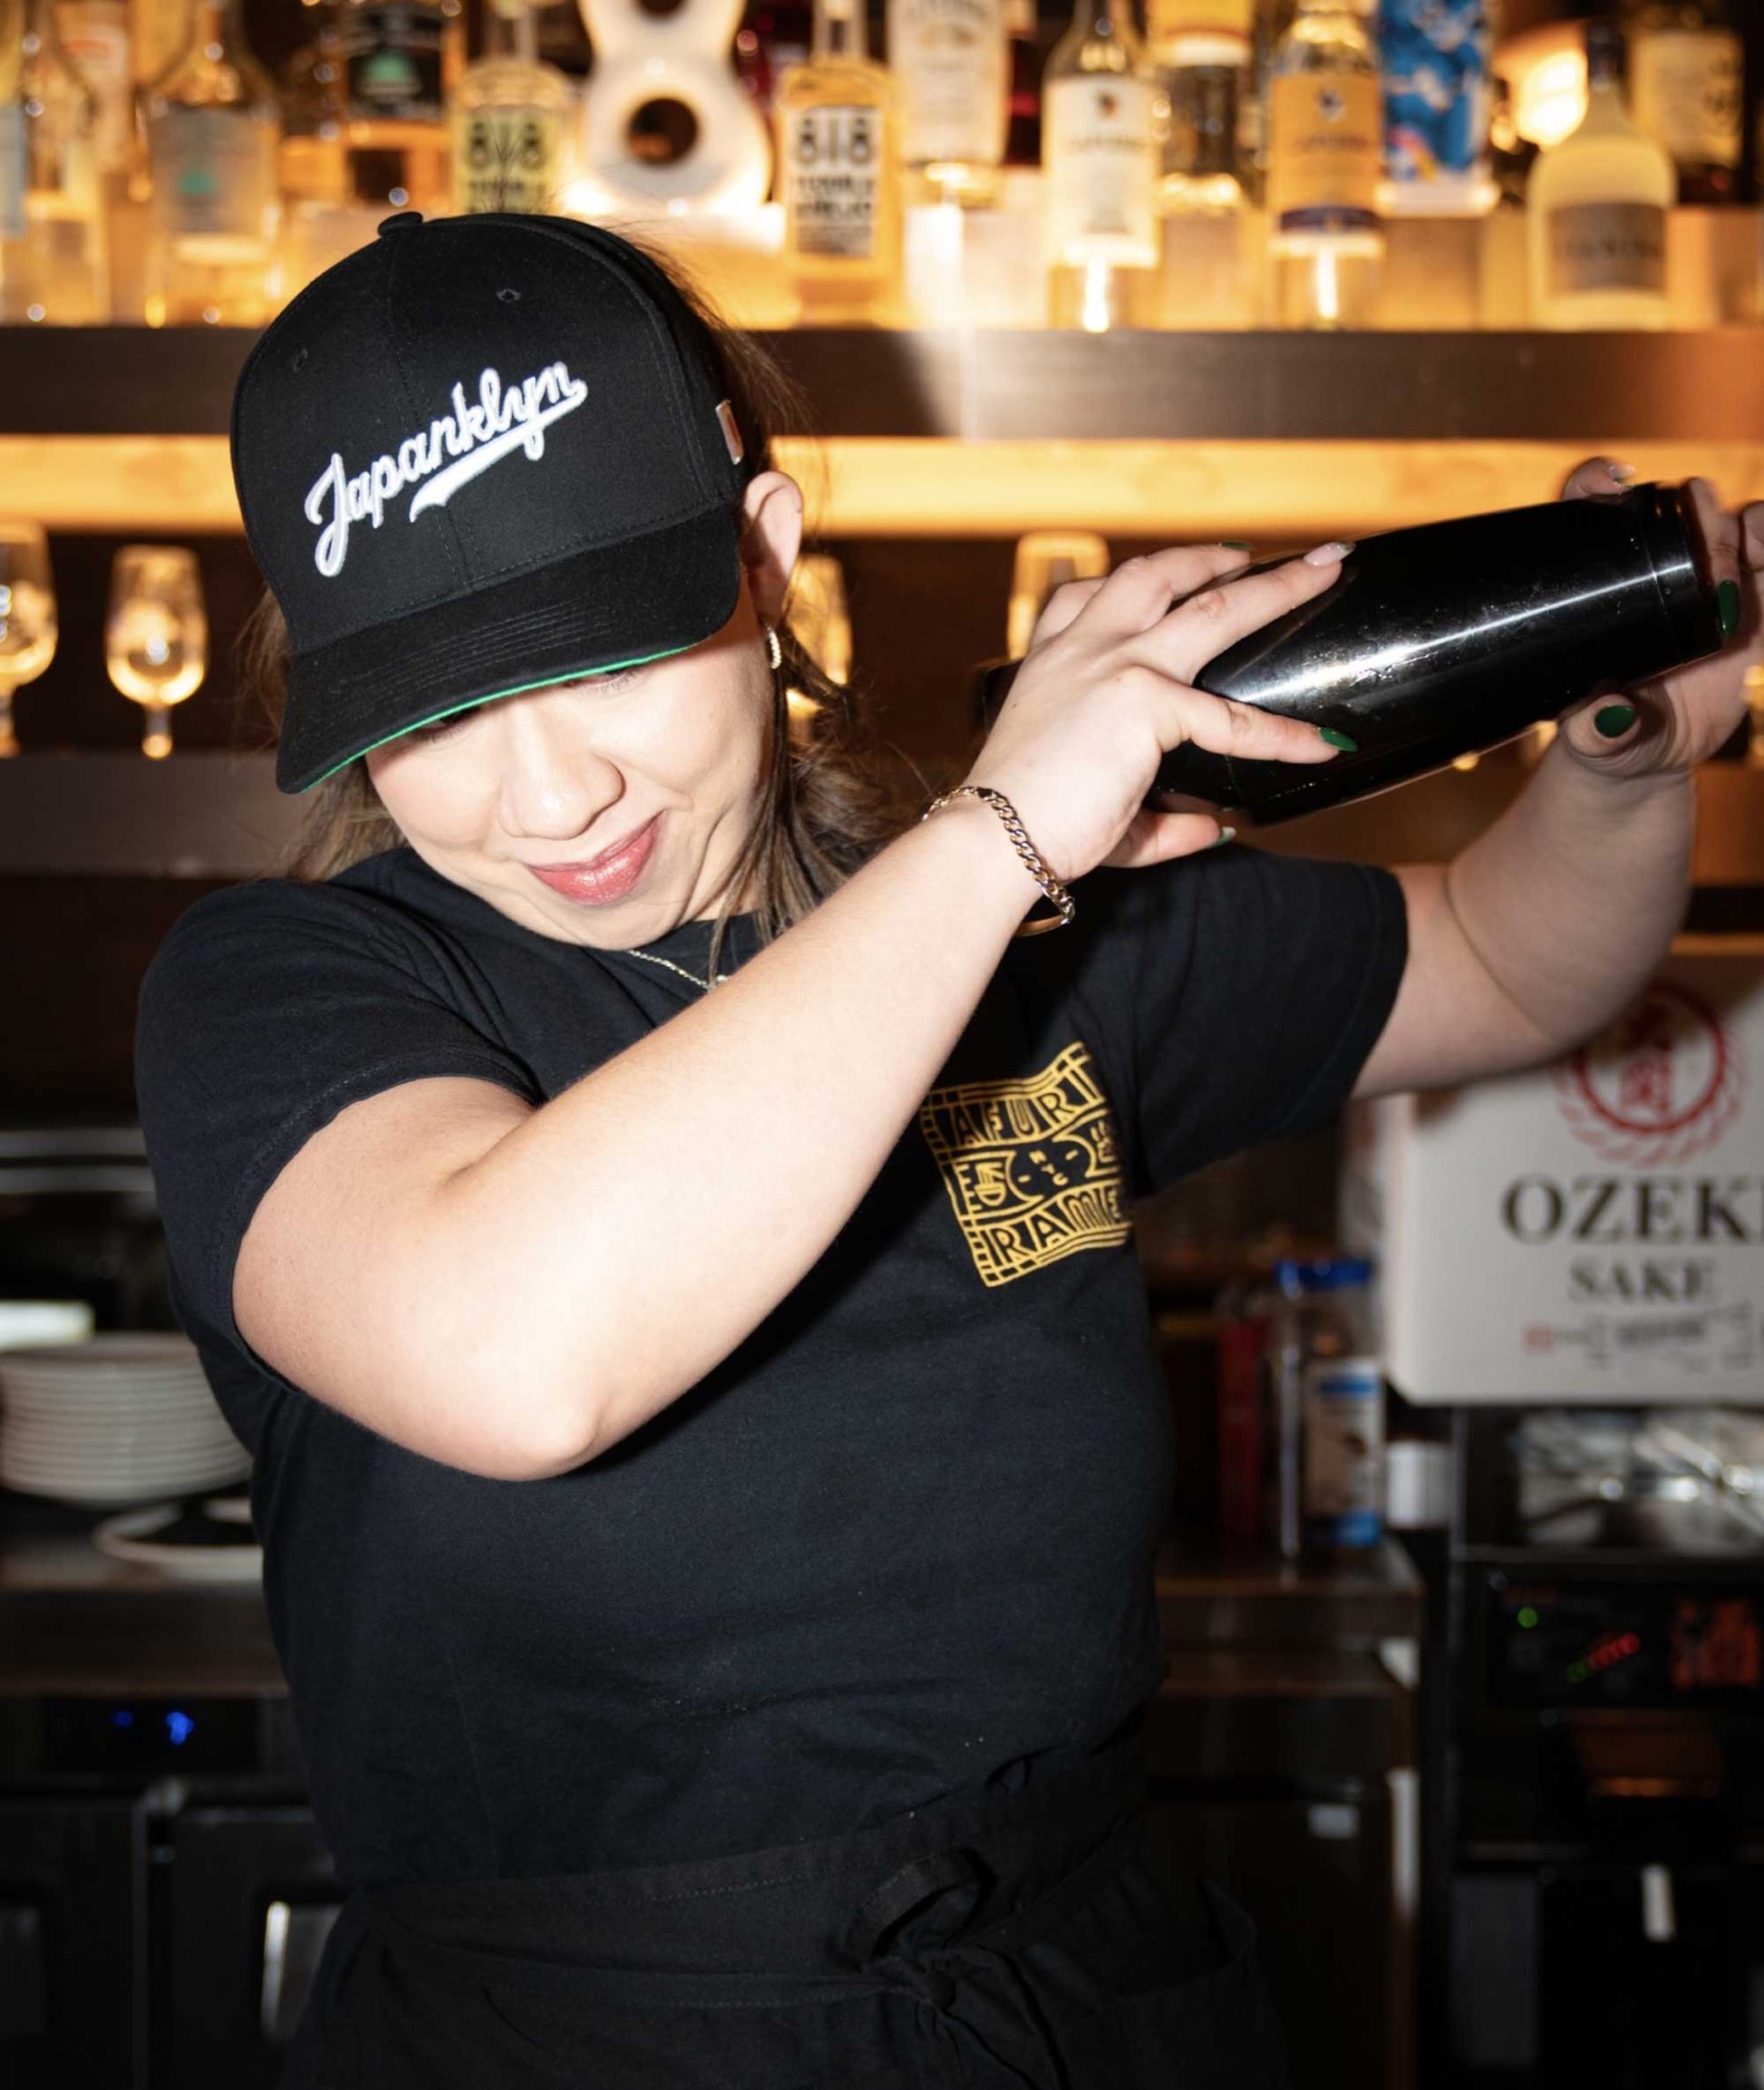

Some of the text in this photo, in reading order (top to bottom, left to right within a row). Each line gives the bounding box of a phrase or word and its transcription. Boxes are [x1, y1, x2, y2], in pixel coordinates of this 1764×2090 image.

[796, 117, 873, 166] 818
[305, 361, 588, 577] Japanklyn
[950, 1062, 1105, 1147] AFURI
[1029, 1148, 1070, 1186] NYC
[986, 1185, 1124, 1267] RAME
[1500, 1173, 1764, 1245] OZEK
[1567, 1257, 1715, 1303] SAKE
